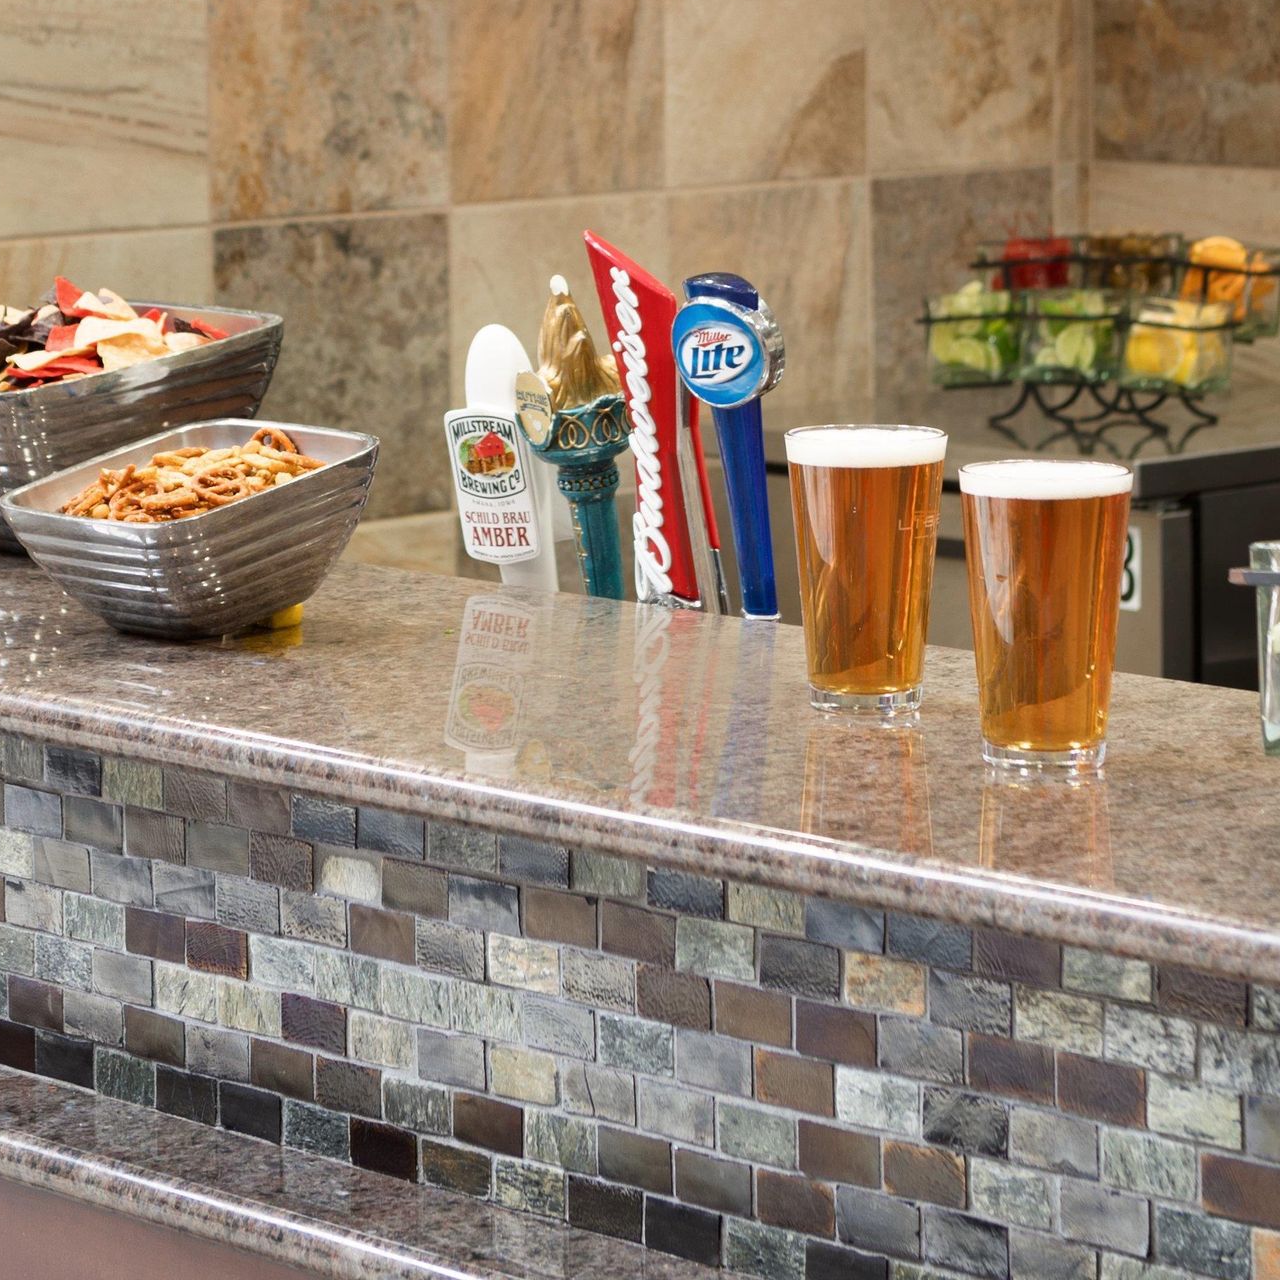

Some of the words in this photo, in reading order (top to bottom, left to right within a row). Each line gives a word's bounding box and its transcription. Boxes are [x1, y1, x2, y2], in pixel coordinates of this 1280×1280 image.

[694, 330, 732, 345] Miller
[690, 343, 746, 379] Lite
[452, 420, 515, 444] MILLSTREAM
[609, 265, 674, 602] Budweiser
[460, 470, 507, 495] BREWING
[464, 509, 500, 525] SCHILD
[502, 511, 531, 524] BRAU
[472, 526, 531, 547] AMBER
